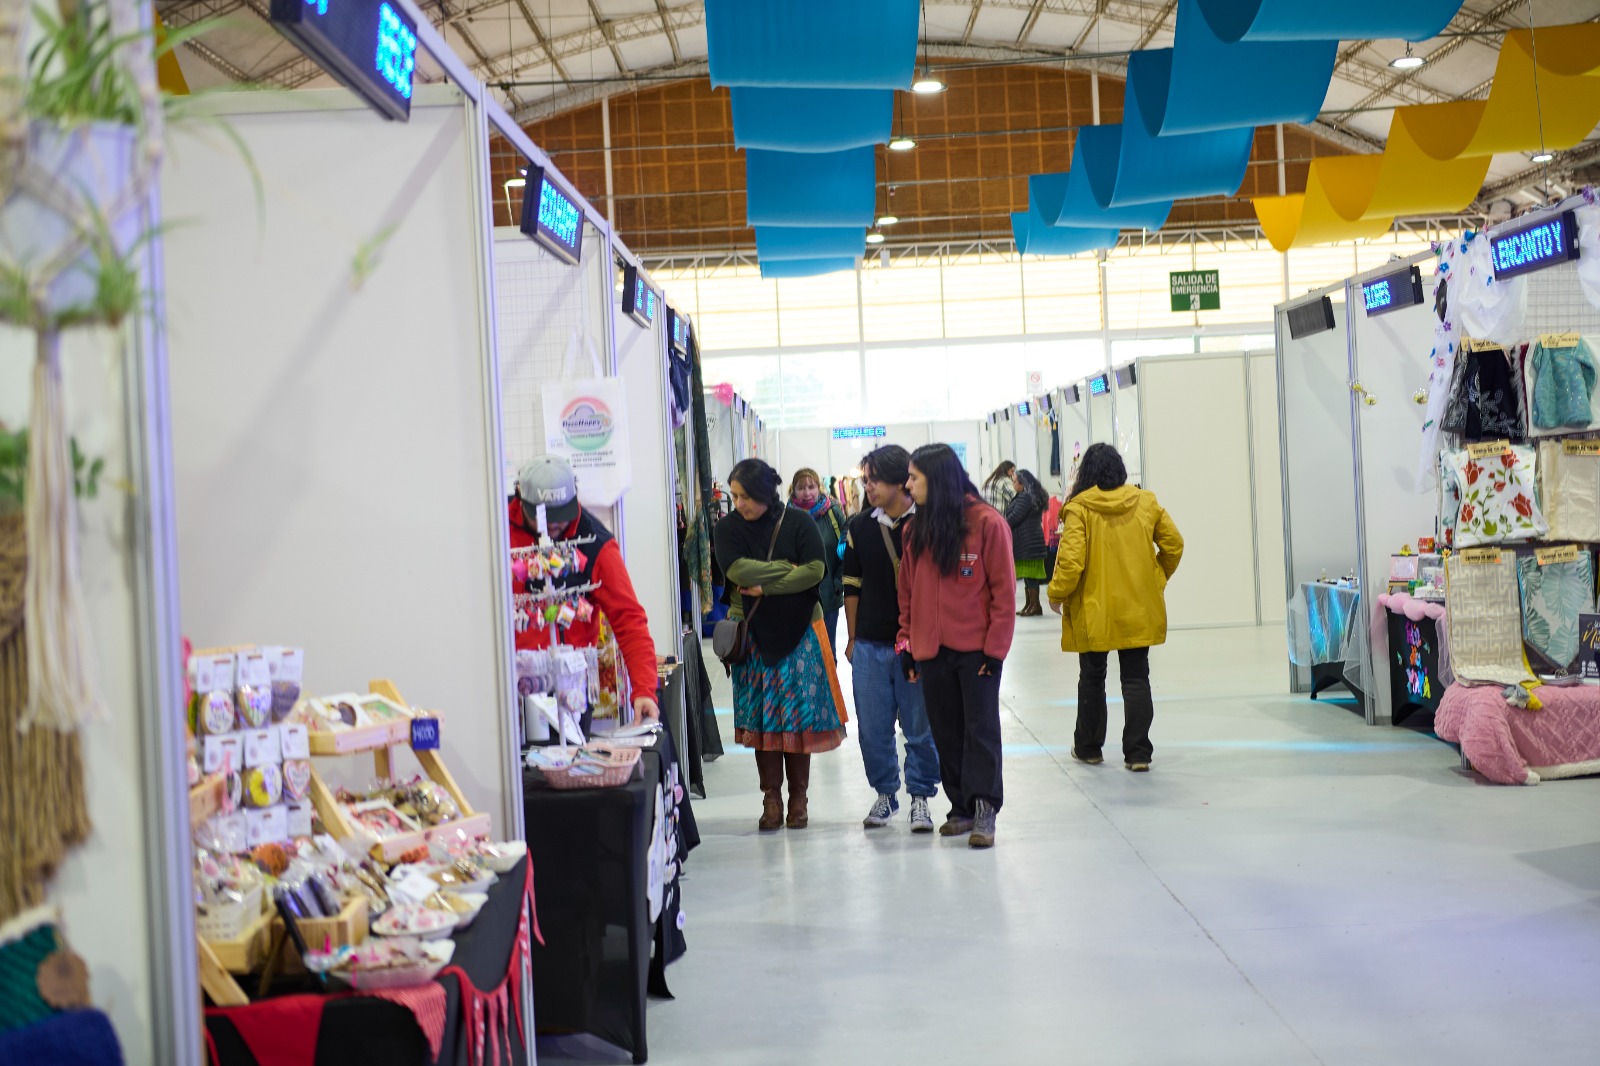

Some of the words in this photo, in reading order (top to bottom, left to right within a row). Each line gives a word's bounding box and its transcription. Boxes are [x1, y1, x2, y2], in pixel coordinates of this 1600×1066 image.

[1497, 224, 1553, 269] ENCANTO
[1551, 220, 1562, 252] Y
[1171, 274, 1203, 286] SALIDA
[1205, 273, 1217, 284] DE
[1172, 284, 1218, 295] EMERGENCIA
[537, 487, 567, 503] VANS
